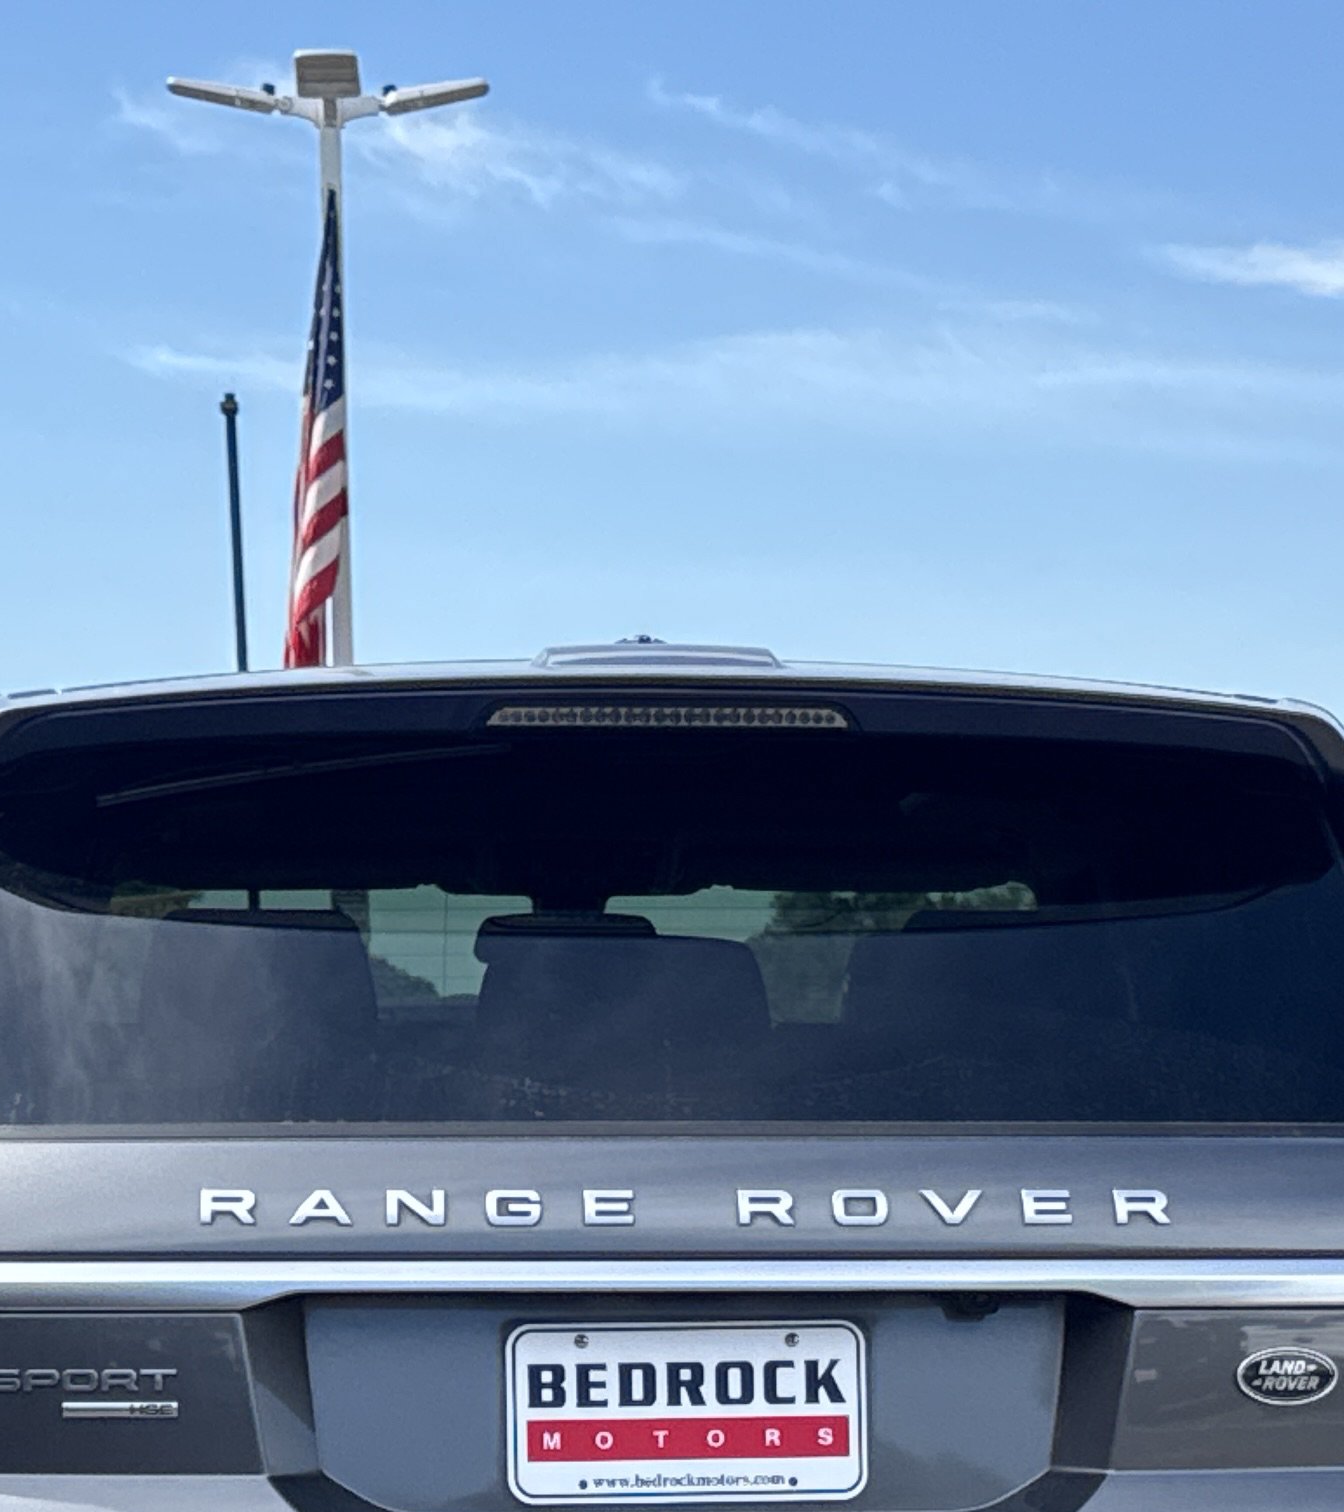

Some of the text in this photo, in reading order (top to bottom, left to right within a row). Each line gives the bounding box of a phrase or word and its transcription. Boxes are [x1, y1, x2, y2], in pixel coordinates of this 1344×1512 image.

[199, 1187, 1172, 1227] RANGE ROVER
[526, 1358, 847, 1409] BEDROCK
[542, 1427, 834, 1451] MOTORS
